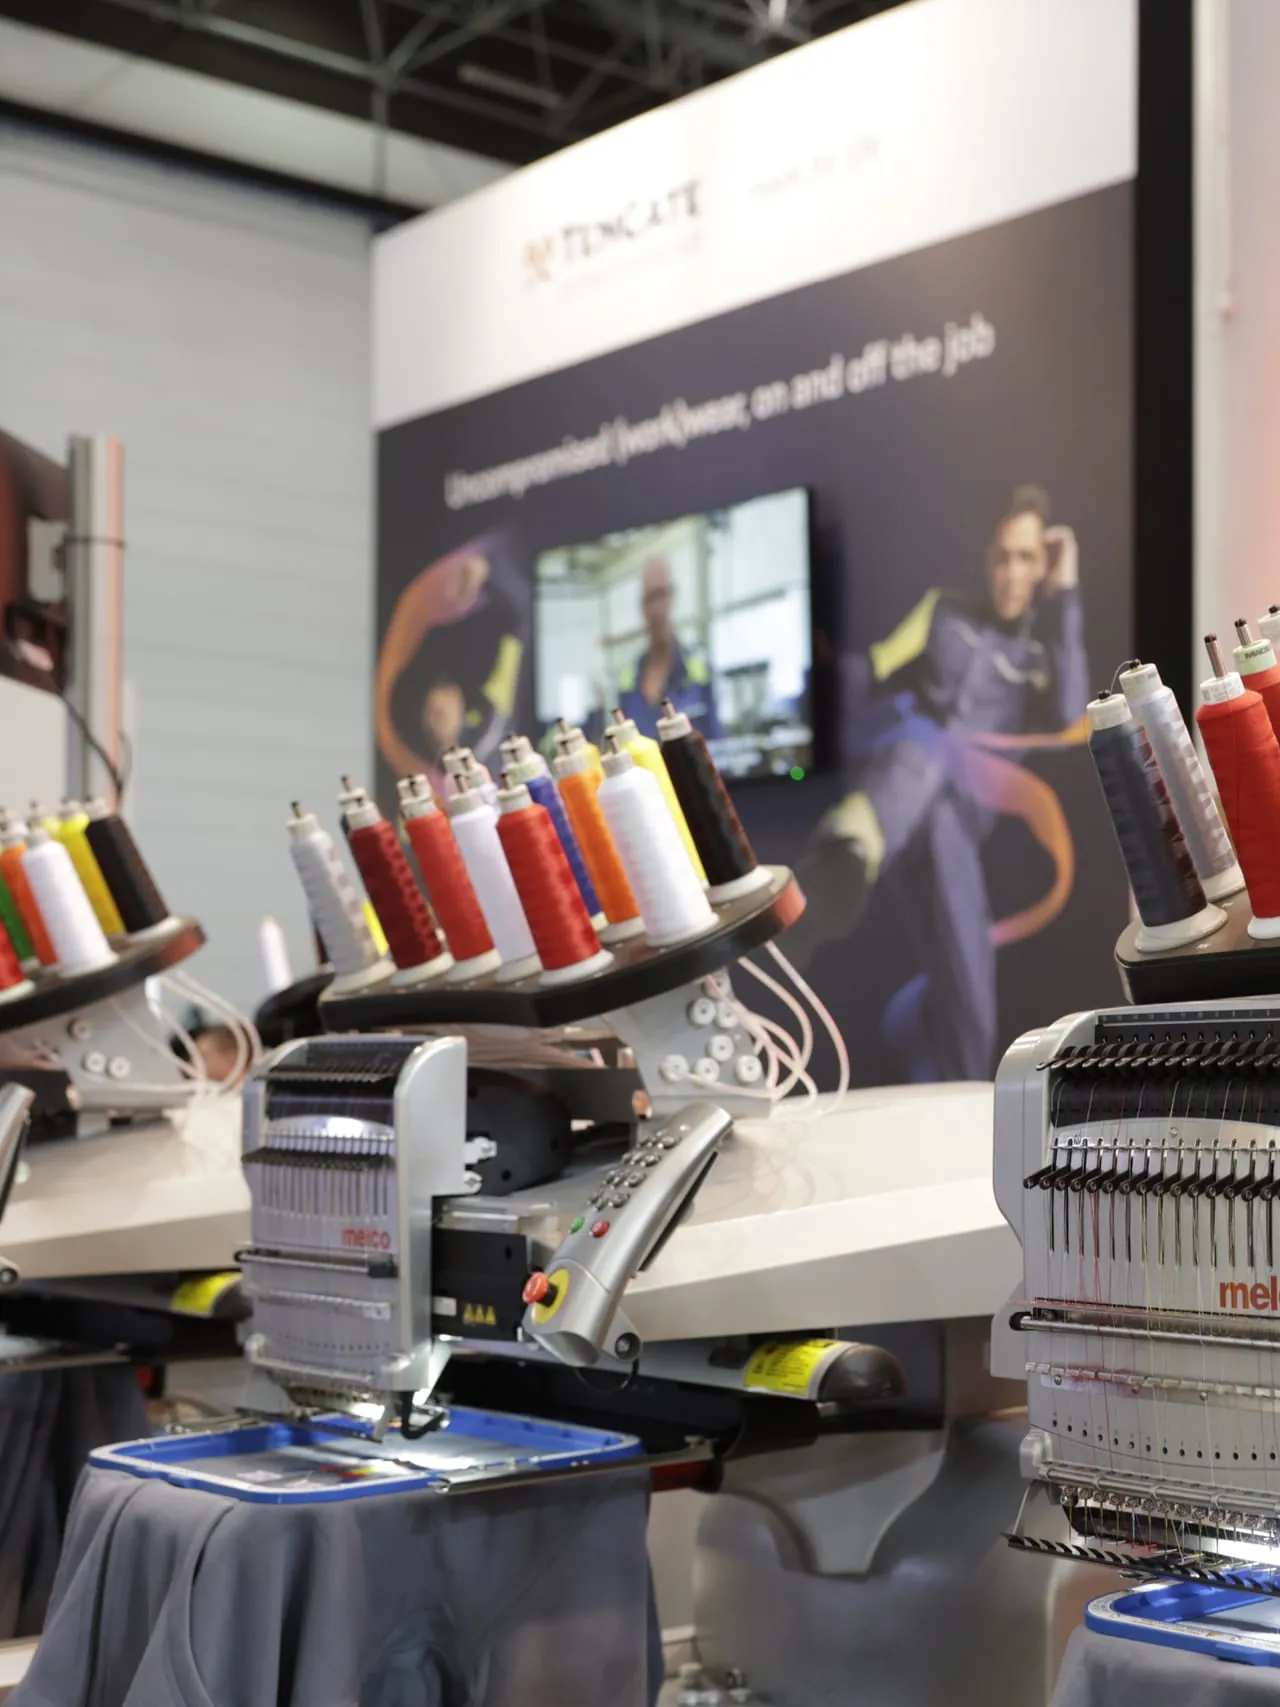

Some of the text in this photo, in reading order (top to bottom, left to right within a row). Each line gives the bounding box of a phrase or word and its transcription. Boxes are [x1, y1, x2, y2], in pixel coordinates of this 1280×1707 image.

[751, 380, 790, 421] on
[790, 352, 845, 410] and
[846, 338, 889, 394] off
[889, 330, 942, 381] the
[941, 310, 996, 378] job
